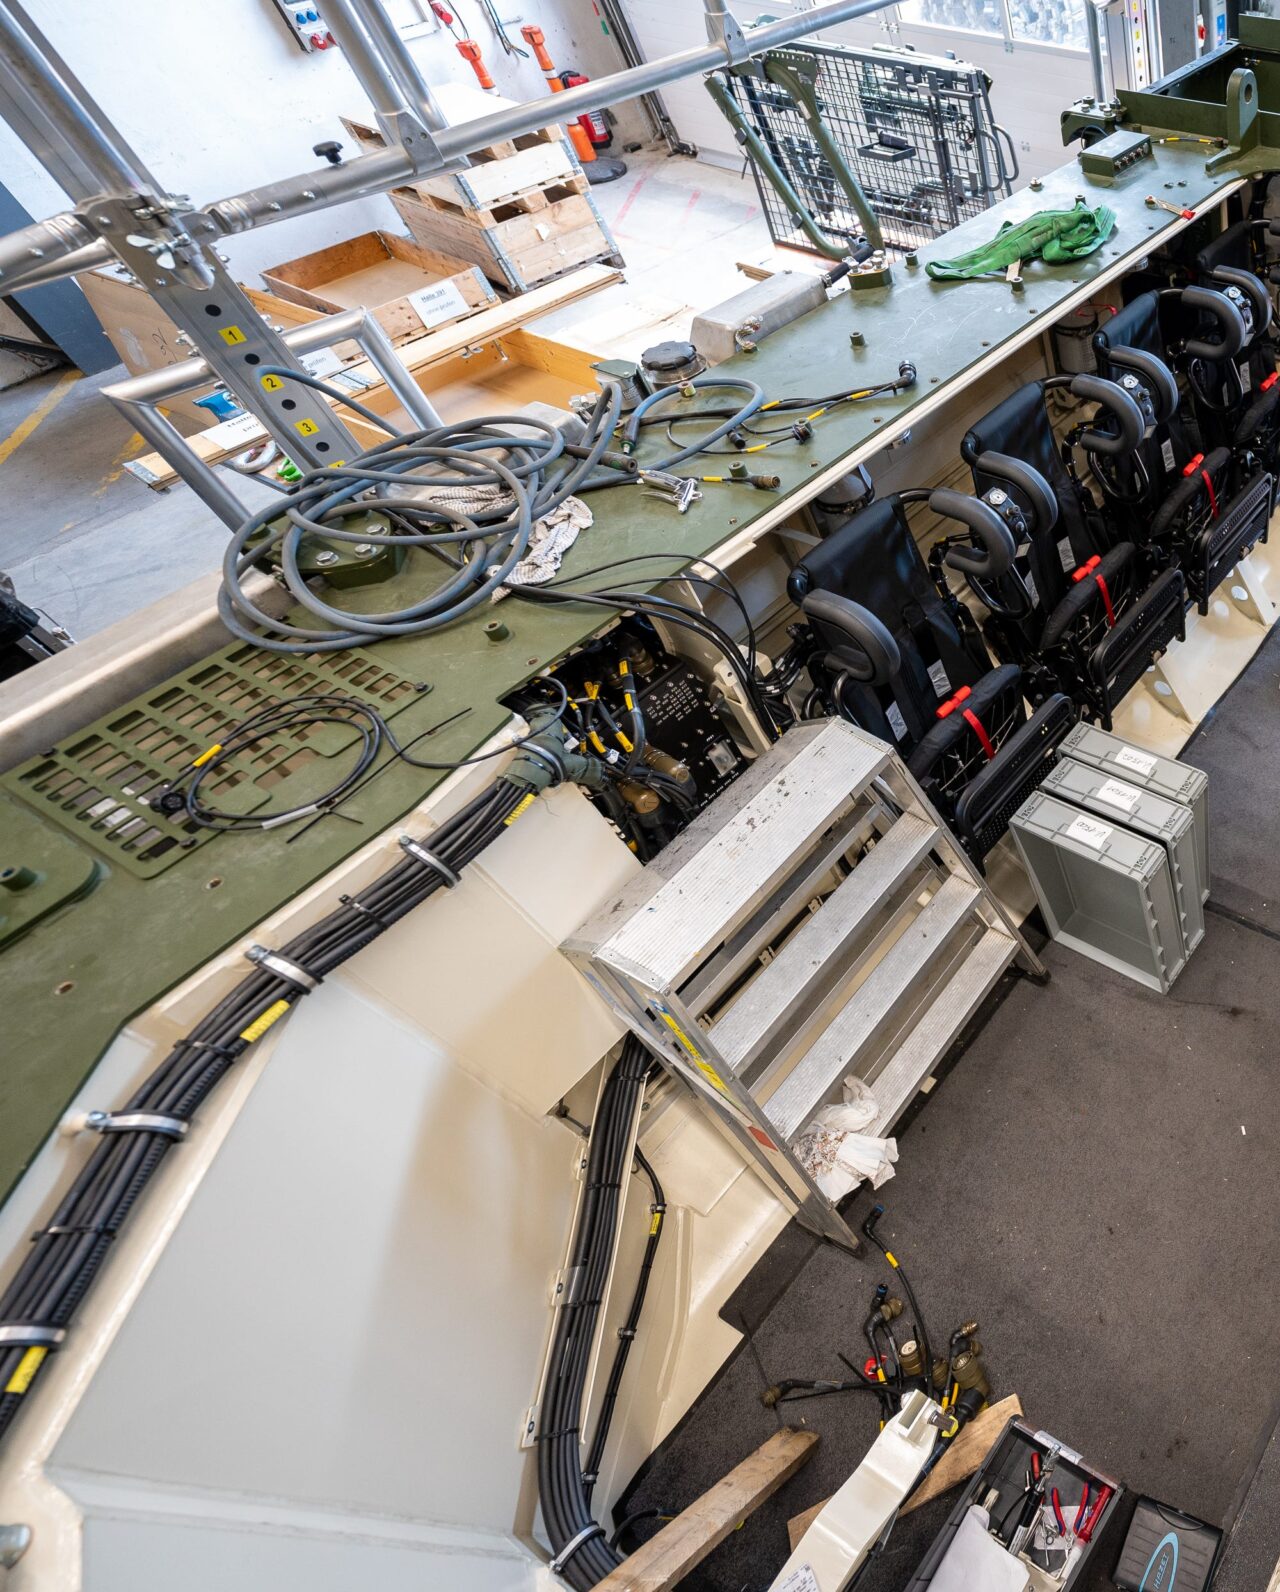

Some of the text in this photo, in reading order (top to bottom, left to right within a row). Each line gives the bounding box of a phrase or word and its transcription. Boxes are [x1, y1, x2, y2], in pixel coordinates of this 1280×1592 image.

[228, 330, 238, 341] 1
[266, 377, 277, 388] 2
[302, 422, 312, 432] 3
[1152, 1552, 1169, 1590] HAZET
